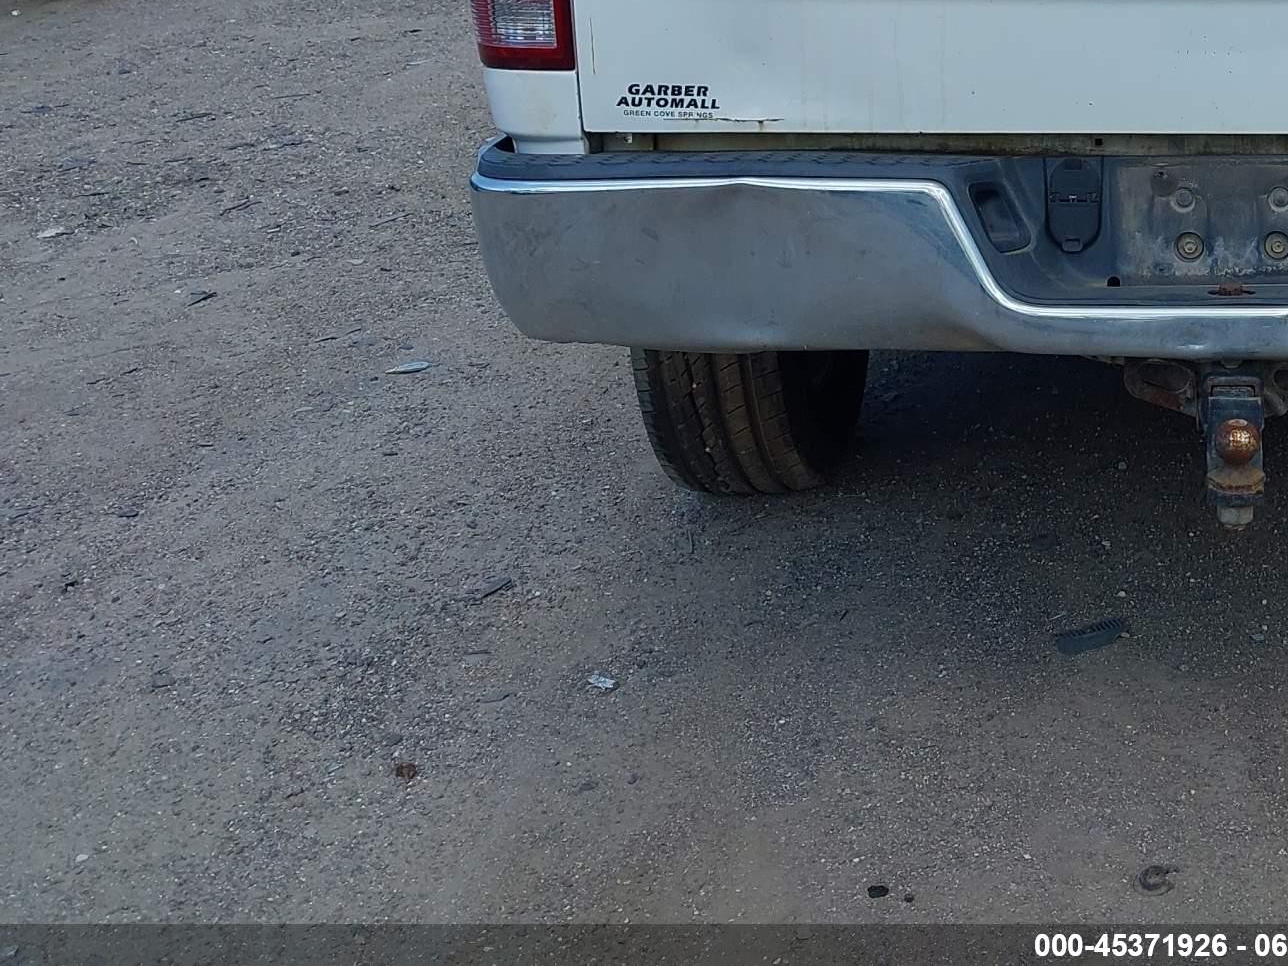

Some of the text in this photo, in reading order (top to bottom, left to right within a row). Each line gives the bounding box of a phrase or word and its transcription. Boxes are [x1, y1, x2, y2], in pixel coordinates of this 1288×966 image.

[627, 83, 709, 97] GARBER
[616, 96, 720, 109] AUTOMALL
[623, 109, 714, 119] GREEN COVE SPRNGS
